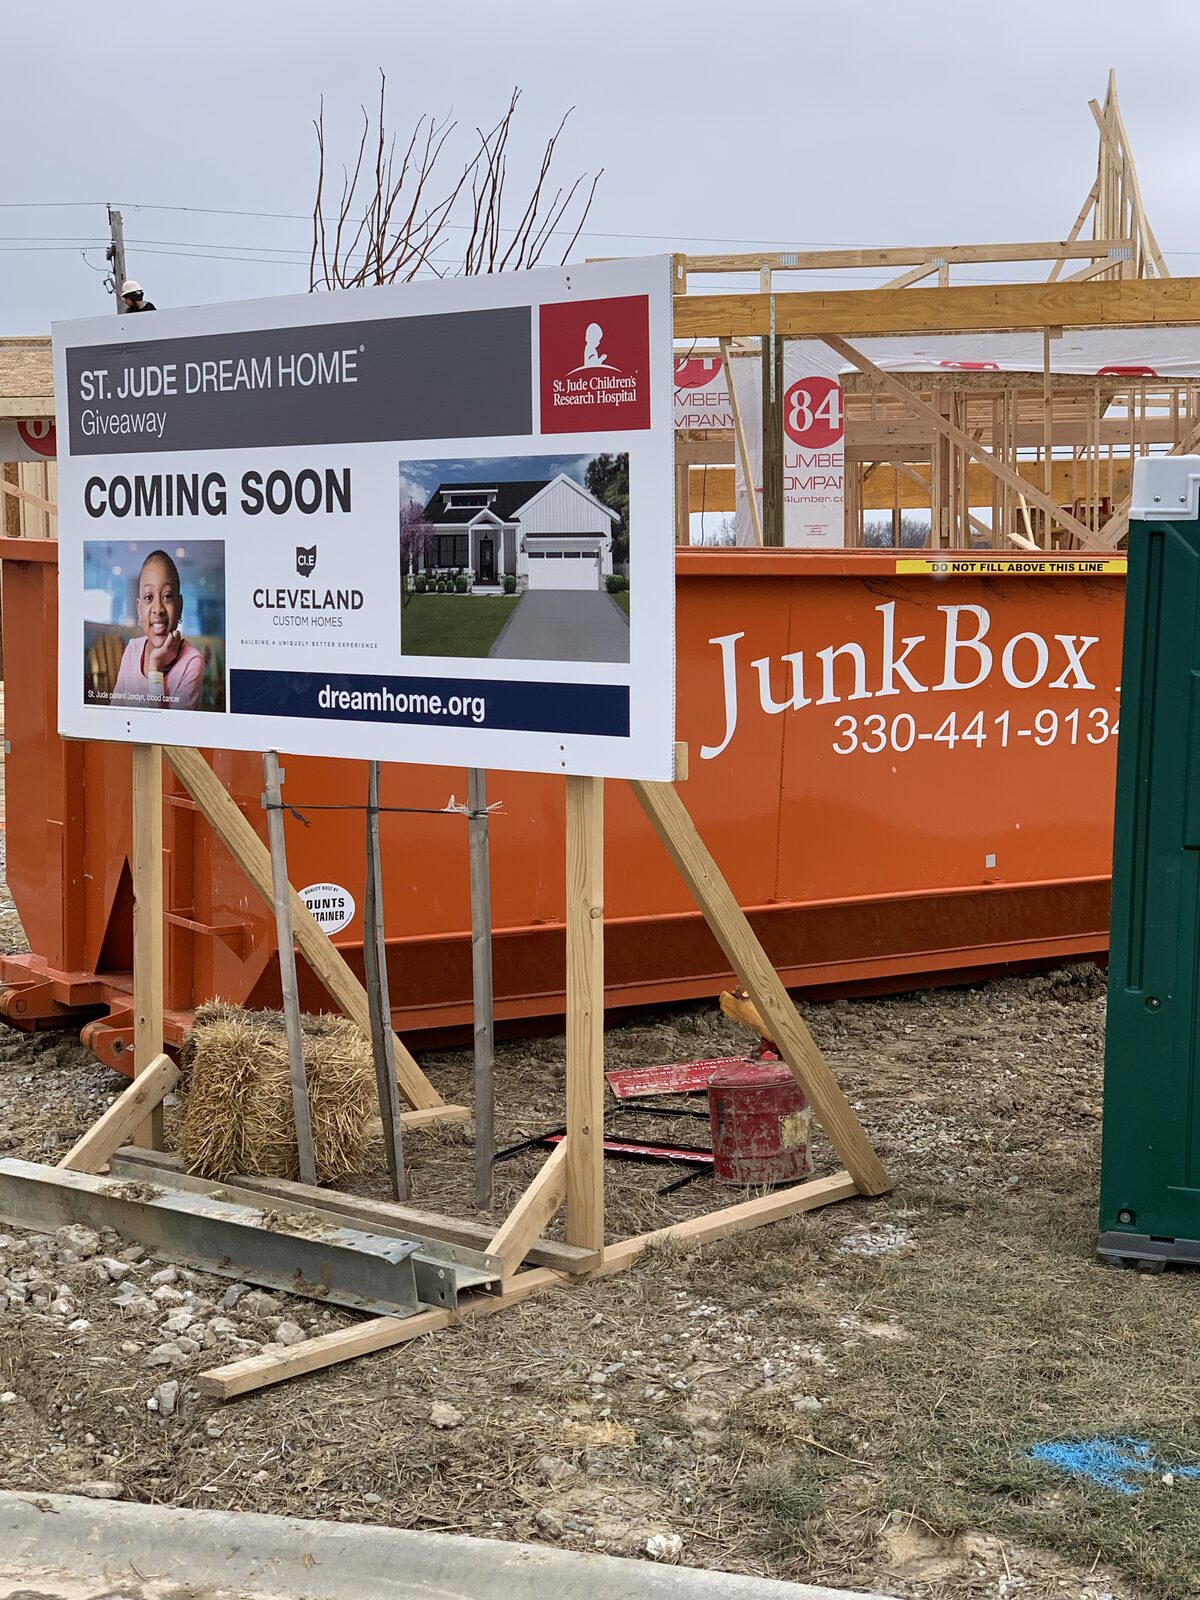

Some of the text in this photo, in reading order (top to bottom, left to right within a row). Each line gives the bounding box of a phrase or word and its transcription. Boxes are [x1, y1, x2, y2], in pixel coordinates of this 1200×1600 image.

[81, 370, 111, 401] ST.
[117, 364, 177, 399] JUDE
[185, 356, 272, 394] DREAM
[553, 375, 637, 394] St. Jude Children's
[553, 388, 637, 407] Research Hospital
[674, 393, 730, 407] MBER
[788, 389, 843, 432] 84
[81, 409, 167, 437] Giveaway
[674, 413, 735, 427] MPANY
[785, 453, 843, 468] UMBE
[84, 467, 351, 518] COMING SOON
[297, 555, 315, 566] CLE
[932, 563, 1103, 572] DO NOT FILL ABOVE THIS LINE
[252, 588, 364, 610] CLEVELAND
[272, 615, 343, 627] CUSTOM HOMES
[700, 601, 1099, 760] JunkBox
[109, 692, 127, 700] patient
[146, 693, 161, 702] blood
[162, 695, 180, 703] cancer
[318, 684, 486, 723] dreamhome.org
[306, 898, 344, 909] OUNTS
[313, 911, 344, 921] TAINER
